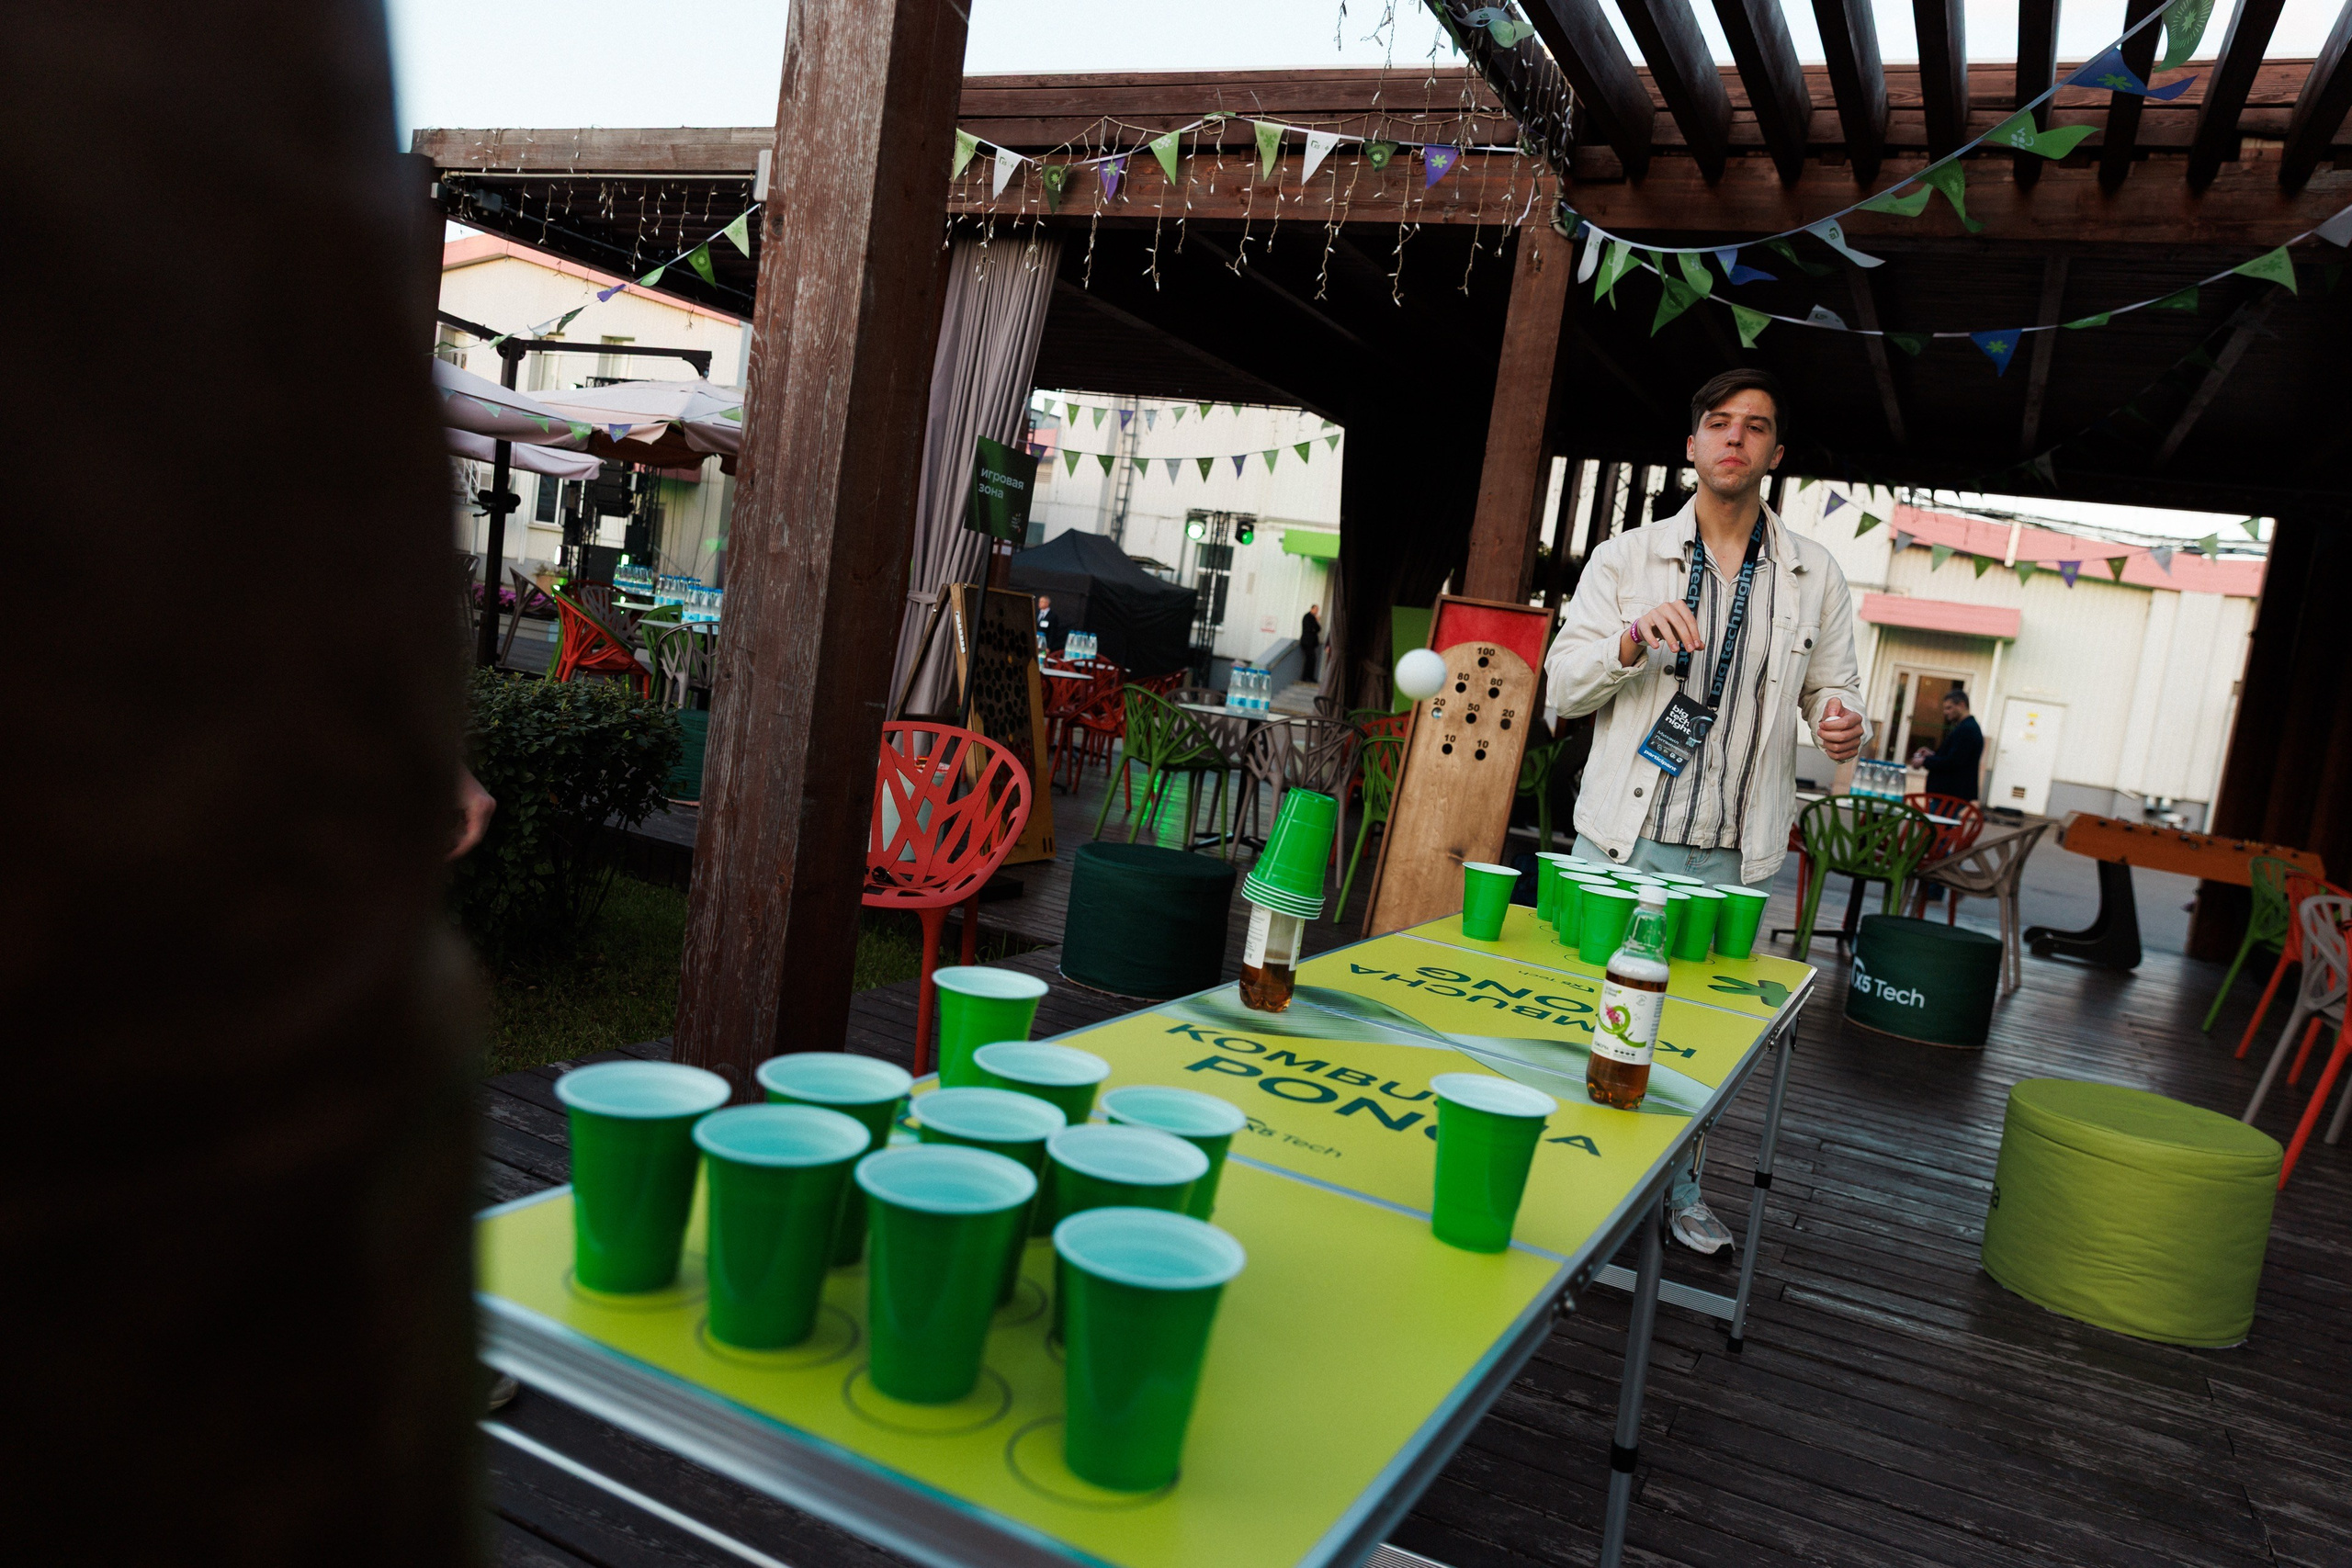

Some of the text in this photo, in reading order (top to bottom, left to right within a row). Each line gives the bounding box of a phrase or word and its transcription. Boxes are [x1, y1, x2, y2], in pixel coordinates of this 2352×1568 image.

[980, 468, 1024, 490] игровая
[978, 483, 1004, 499] зона
[1687, 564, 1703, 609] tech
[1712, 561, 1754, 696] big tech night
[1477, 647, 1496, 657] 100
[1457, 672, 1469, 682] 80
[1490, 678, 1503, 687] 80
[1433, 698, 1445, 706] 20
[1467, 704, 1480, 712] 50
[1502, 709, 1515, 718] 20
[1669, 711, 1690, 727] tech
[1672, 705, 1689, 719] big
[1665, 716, 1691, 735] night
[1444, 735, 1456, 743] 10
[1476, 739, 1489, 749] 10
[1644, 750, 1677, 772] participant
[1416, 966, 1599, 1017] ONG
[1874, 978, 1925, 1009] Tech
[1350, 963, 1697, 1059] KMBUCHA
[1165, 1023, 1601, 1157] KOMBUA
[1183, 1055, 1437, 1141] PON
[1283, 1134, 1342, 1157] Tech
